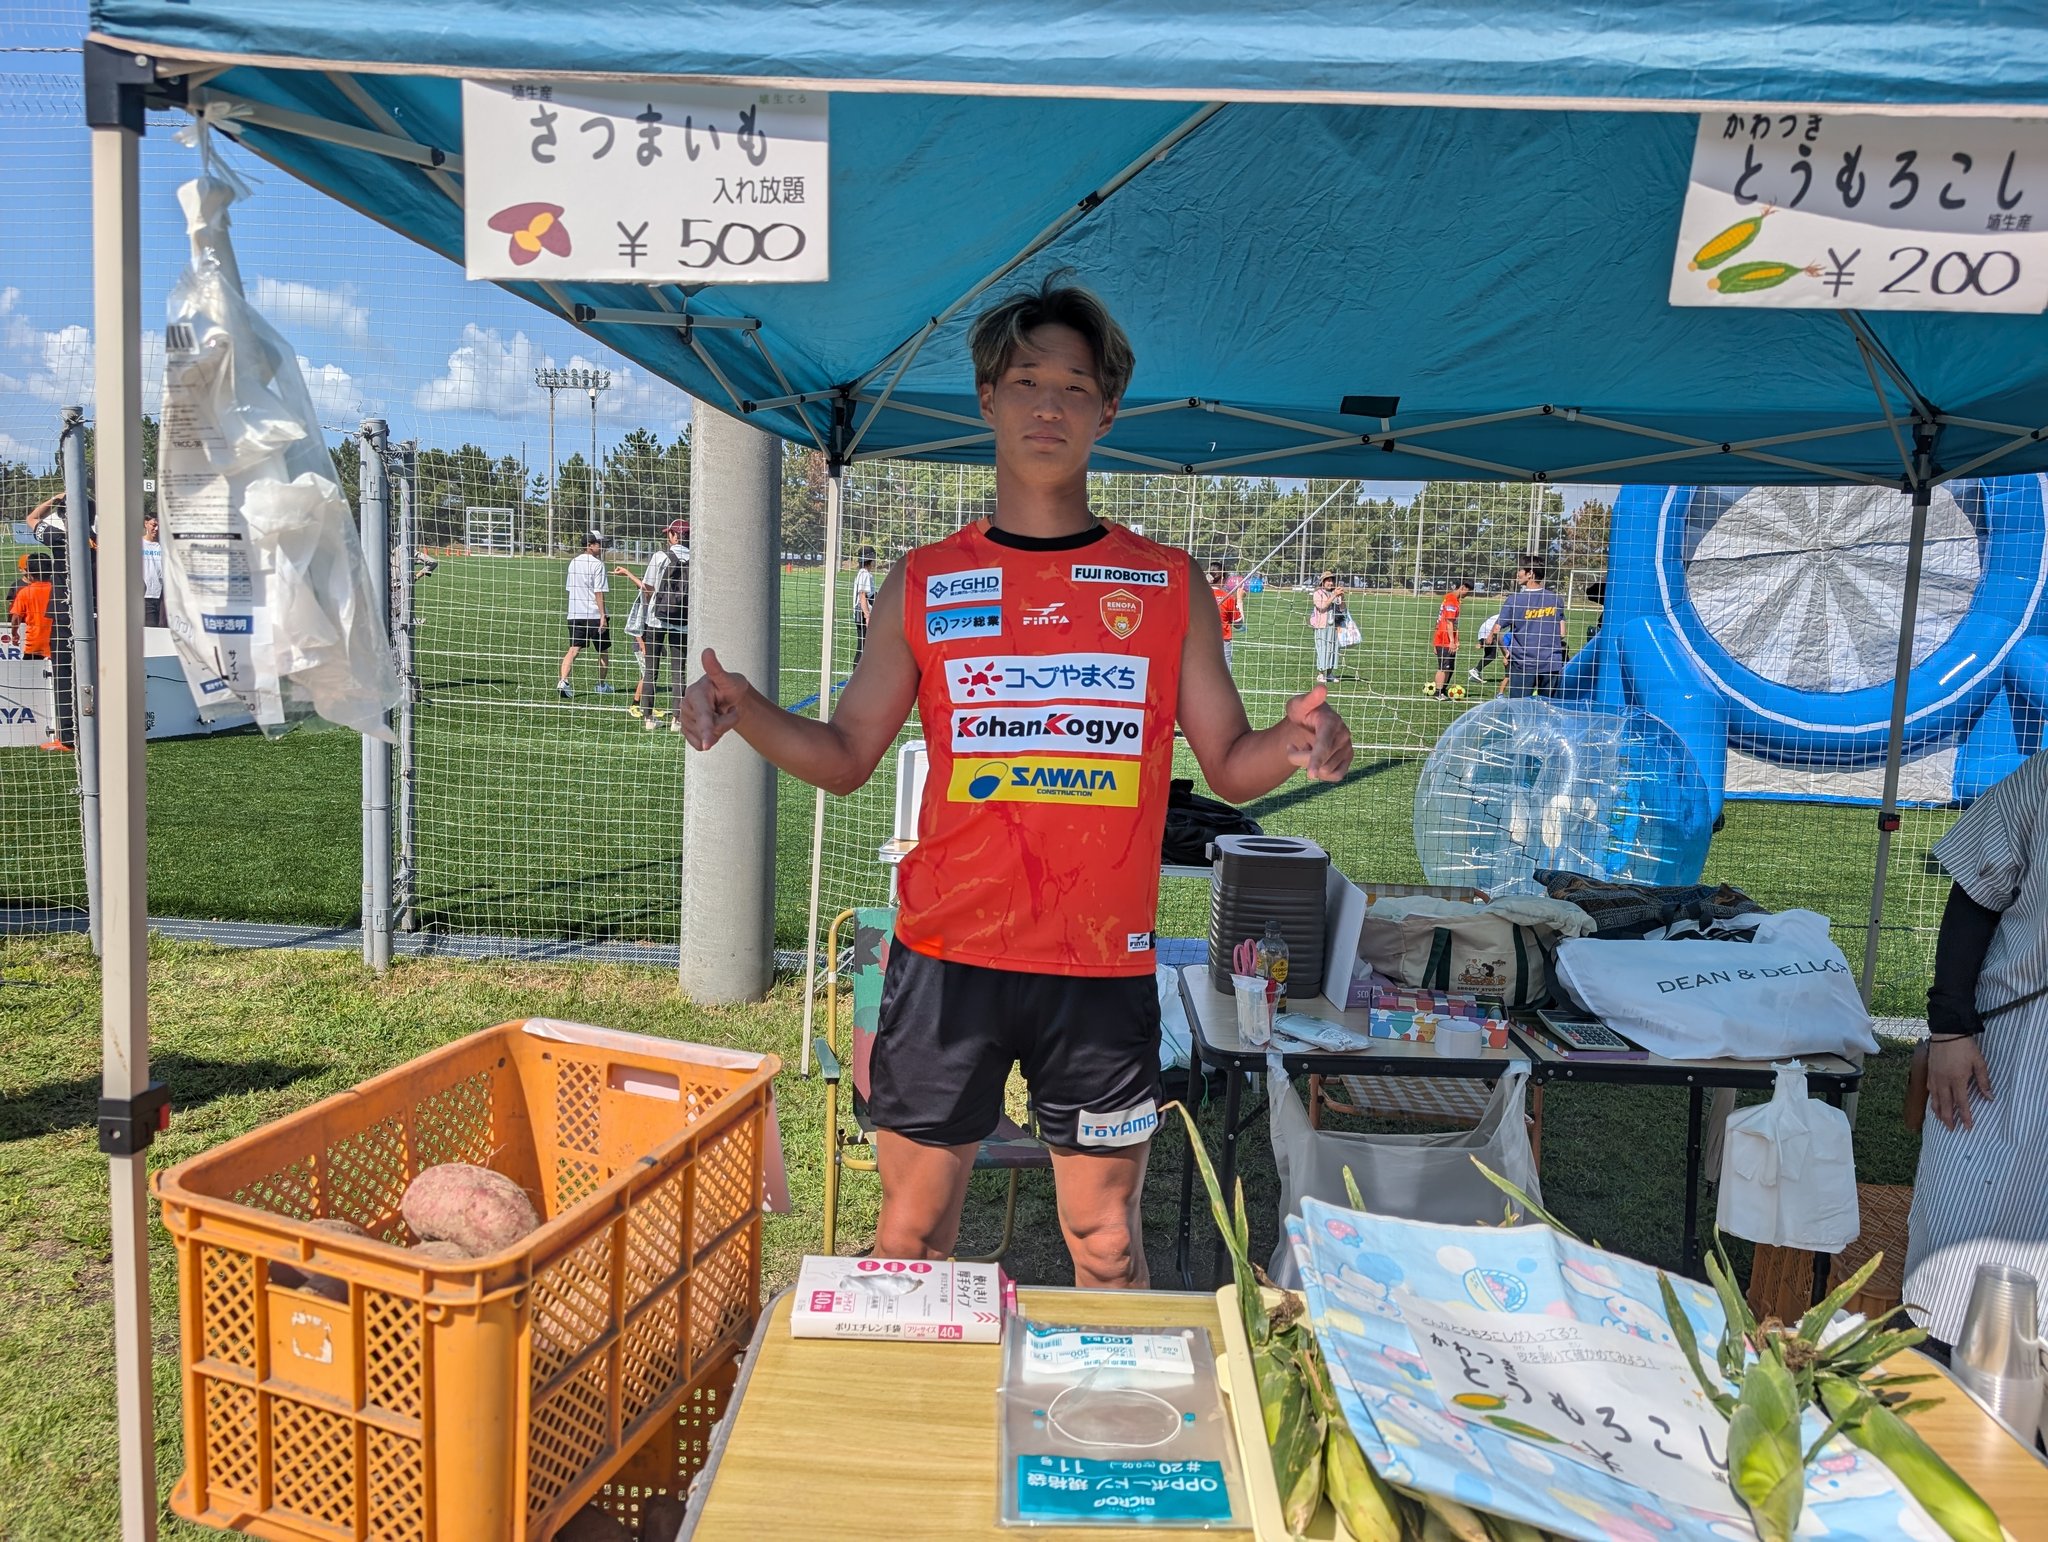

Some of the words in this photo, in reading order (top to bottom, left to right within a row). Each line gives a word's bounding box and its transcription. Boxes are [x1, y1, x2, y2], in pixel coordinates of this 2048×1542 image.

[530, 104, 767, 166] さつまいも
[1723, 114, 1822, 141] かわつき
[1734, 143, 2023, 210] とうもろこし
[713, 177, 805, 205] 入れ放題
[678, 219, 806, 268] 500
[1880, 247, 2021, 296] 200
[950, 576, 999, 592] FGHD
[1075, 568, 1101, 580] FUJI
[1105, 569, 1165, 583] ROBOTICS
[950, 615, 999, 629] フジ総業
[0, 708, 36, 724] YA
[1037, 788, 1093, 797] CONSTRUCTION
[1656, 970, 1732, 994] DEAN
[1738, 969, 1756, 980] &
